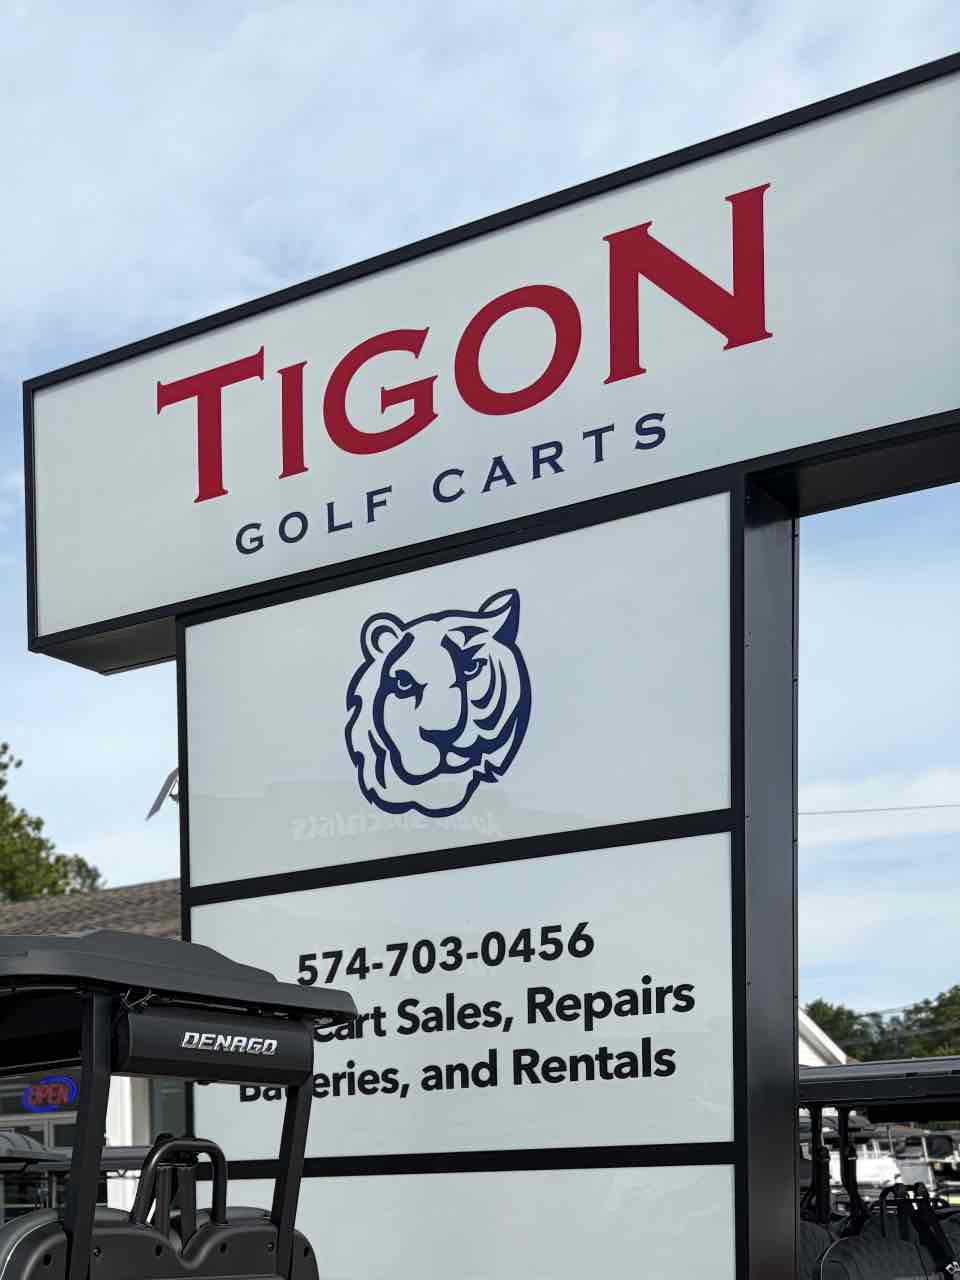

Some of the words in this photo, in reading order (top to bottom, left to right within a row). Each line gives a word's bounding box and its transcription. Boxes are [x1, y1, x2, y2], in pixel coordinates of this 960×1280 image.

[157, 183, 773, 502] TIGON
[236, 484, 393, 554] GOLF
[433, 413, 666, 503] CARTS
[297, 922, 595, 987] 574-703-0456
[397, 993, 514, 1036] Sales,
[527, 975, 696, 1033] Repairs
[181, 1031, 279, 1056] DENAGO
[239, 1059, 410, 1103] aeries,
[421, 1047, 498, 1092] and
[512, 1037, 676, 1086] Rentals
[28, 1084, 68, 1106] OPEN
